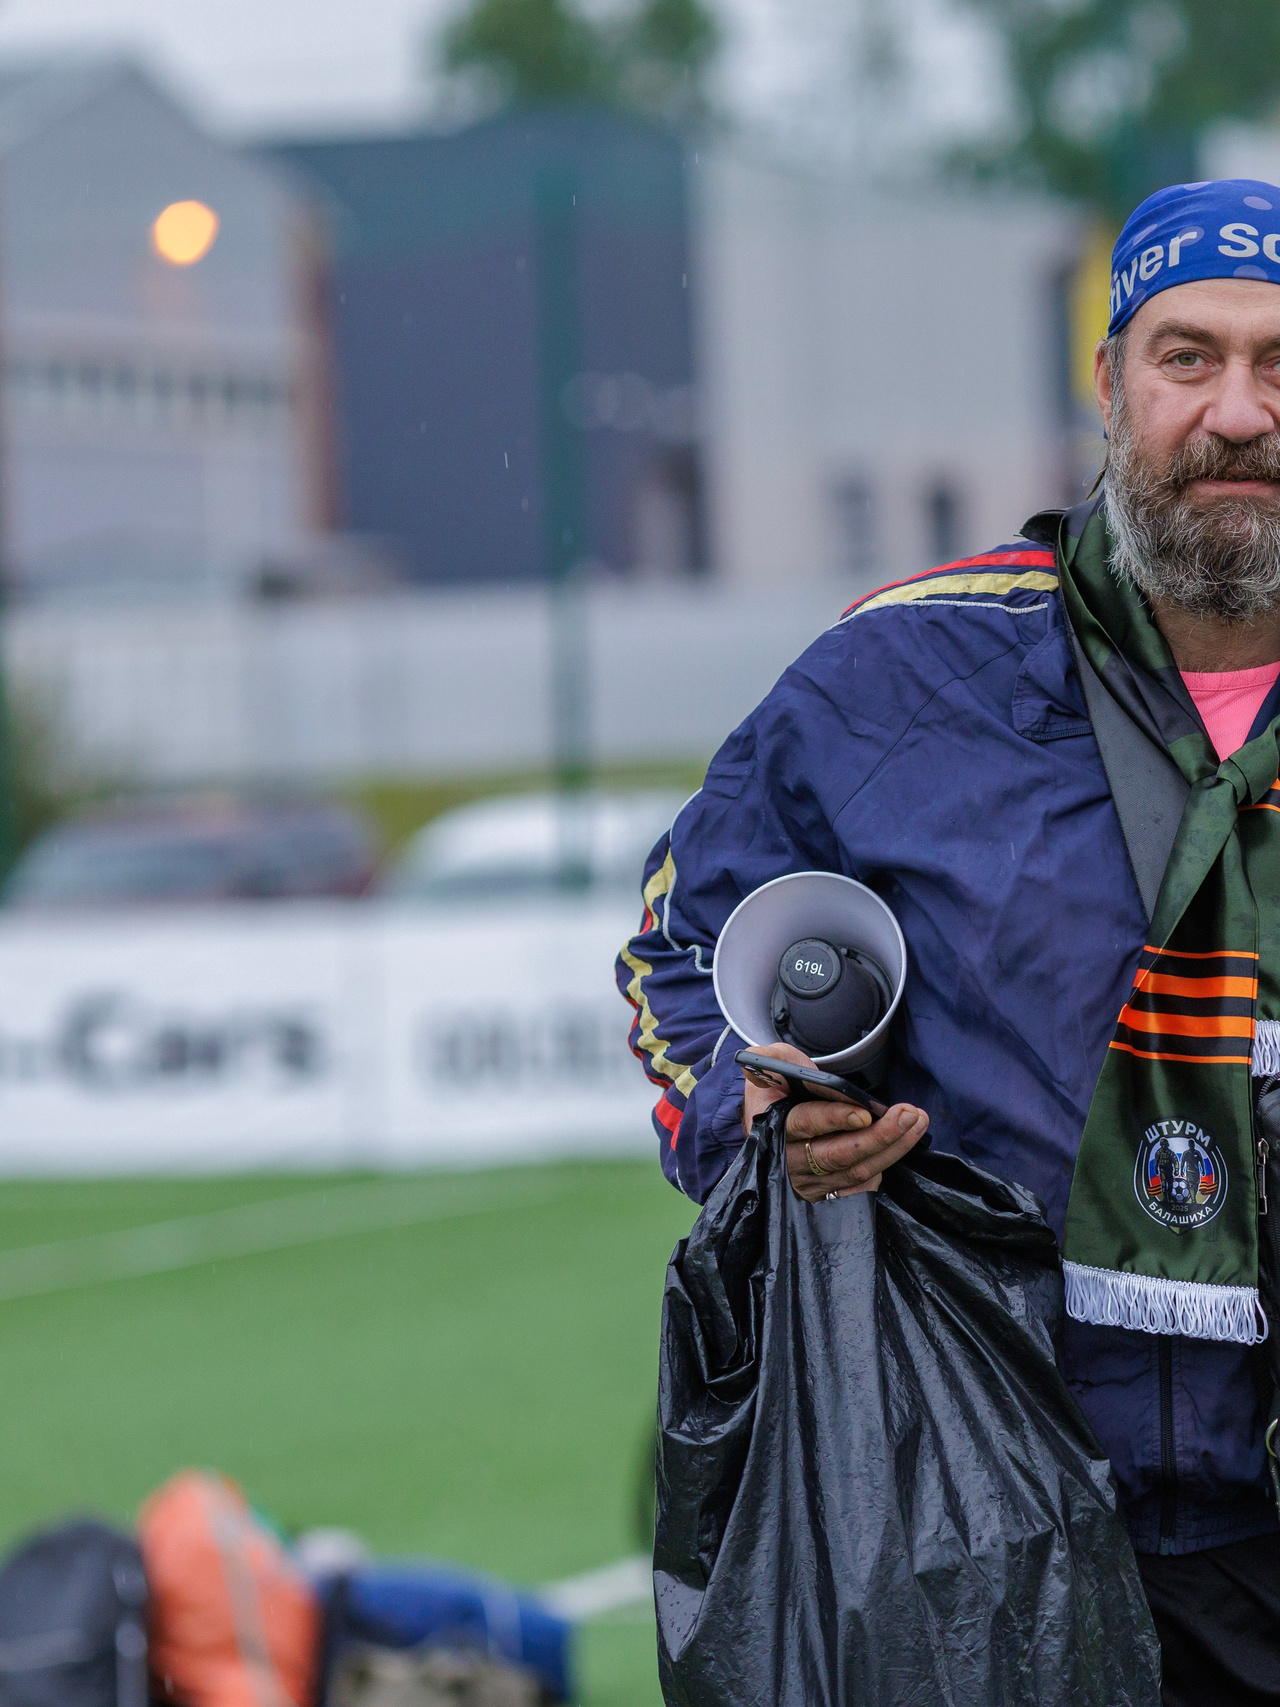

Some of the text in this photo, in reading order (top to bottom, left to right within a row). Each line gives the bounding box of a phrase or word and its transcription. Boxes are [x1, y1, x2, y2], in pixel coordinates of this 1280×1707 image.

[794, 959, 825, 977] 619L
[1144, 1120, 1211, 1147] ШТУРМ
[1148, 1201, 1213, 1224] БАЛАШИХА
[1171, 1204, 1189, 1212] 2025
